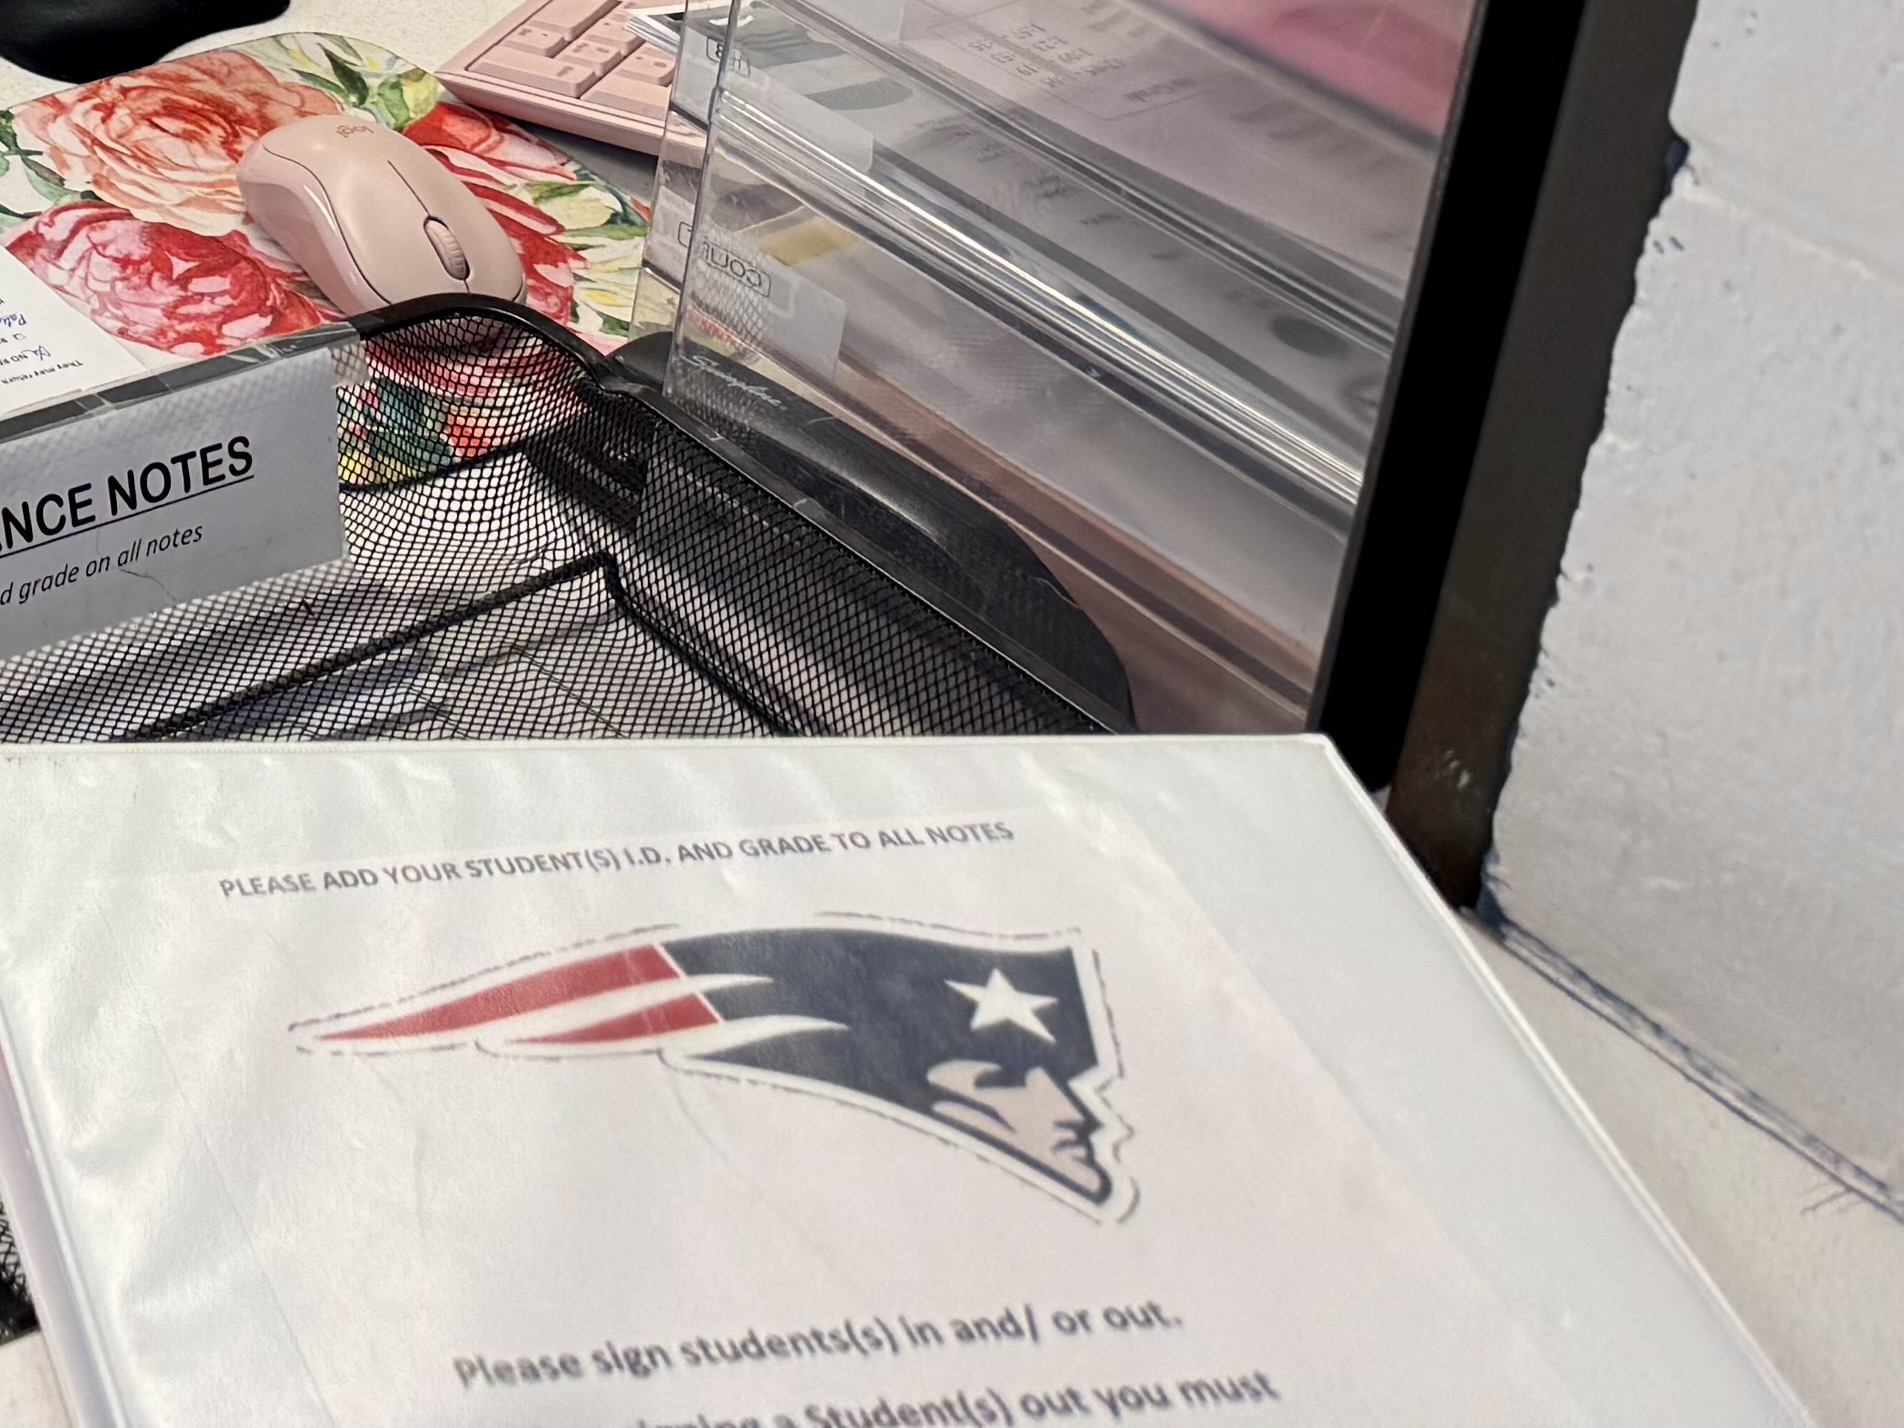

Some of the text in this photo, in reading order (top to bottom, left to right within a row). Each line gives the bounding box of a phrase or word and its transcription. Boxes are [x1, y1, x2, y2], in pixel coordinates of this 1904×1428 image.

[108, 435, 254, 518] NOTES
[18, 562, 81, 607] grade
[85, 555, 111, 578] on
[116, 537, 143, 568] all
[145, 522, 205, 559] notes
[218, 818, 1016, 900] PLEASE ADD YOUR STUDENT(S) I.D. AND GRADE TO ALL NOTES
[452, 1296, 1184, 1393] Please sign students(s) in and/ or out.
[804, 1386, 1014, 1428] Student(s)
[1019, 1386, 1084, 1421] out
[1089, 1382, 1171, 1427] you
[1178, 1369, 1277, 1407] must
